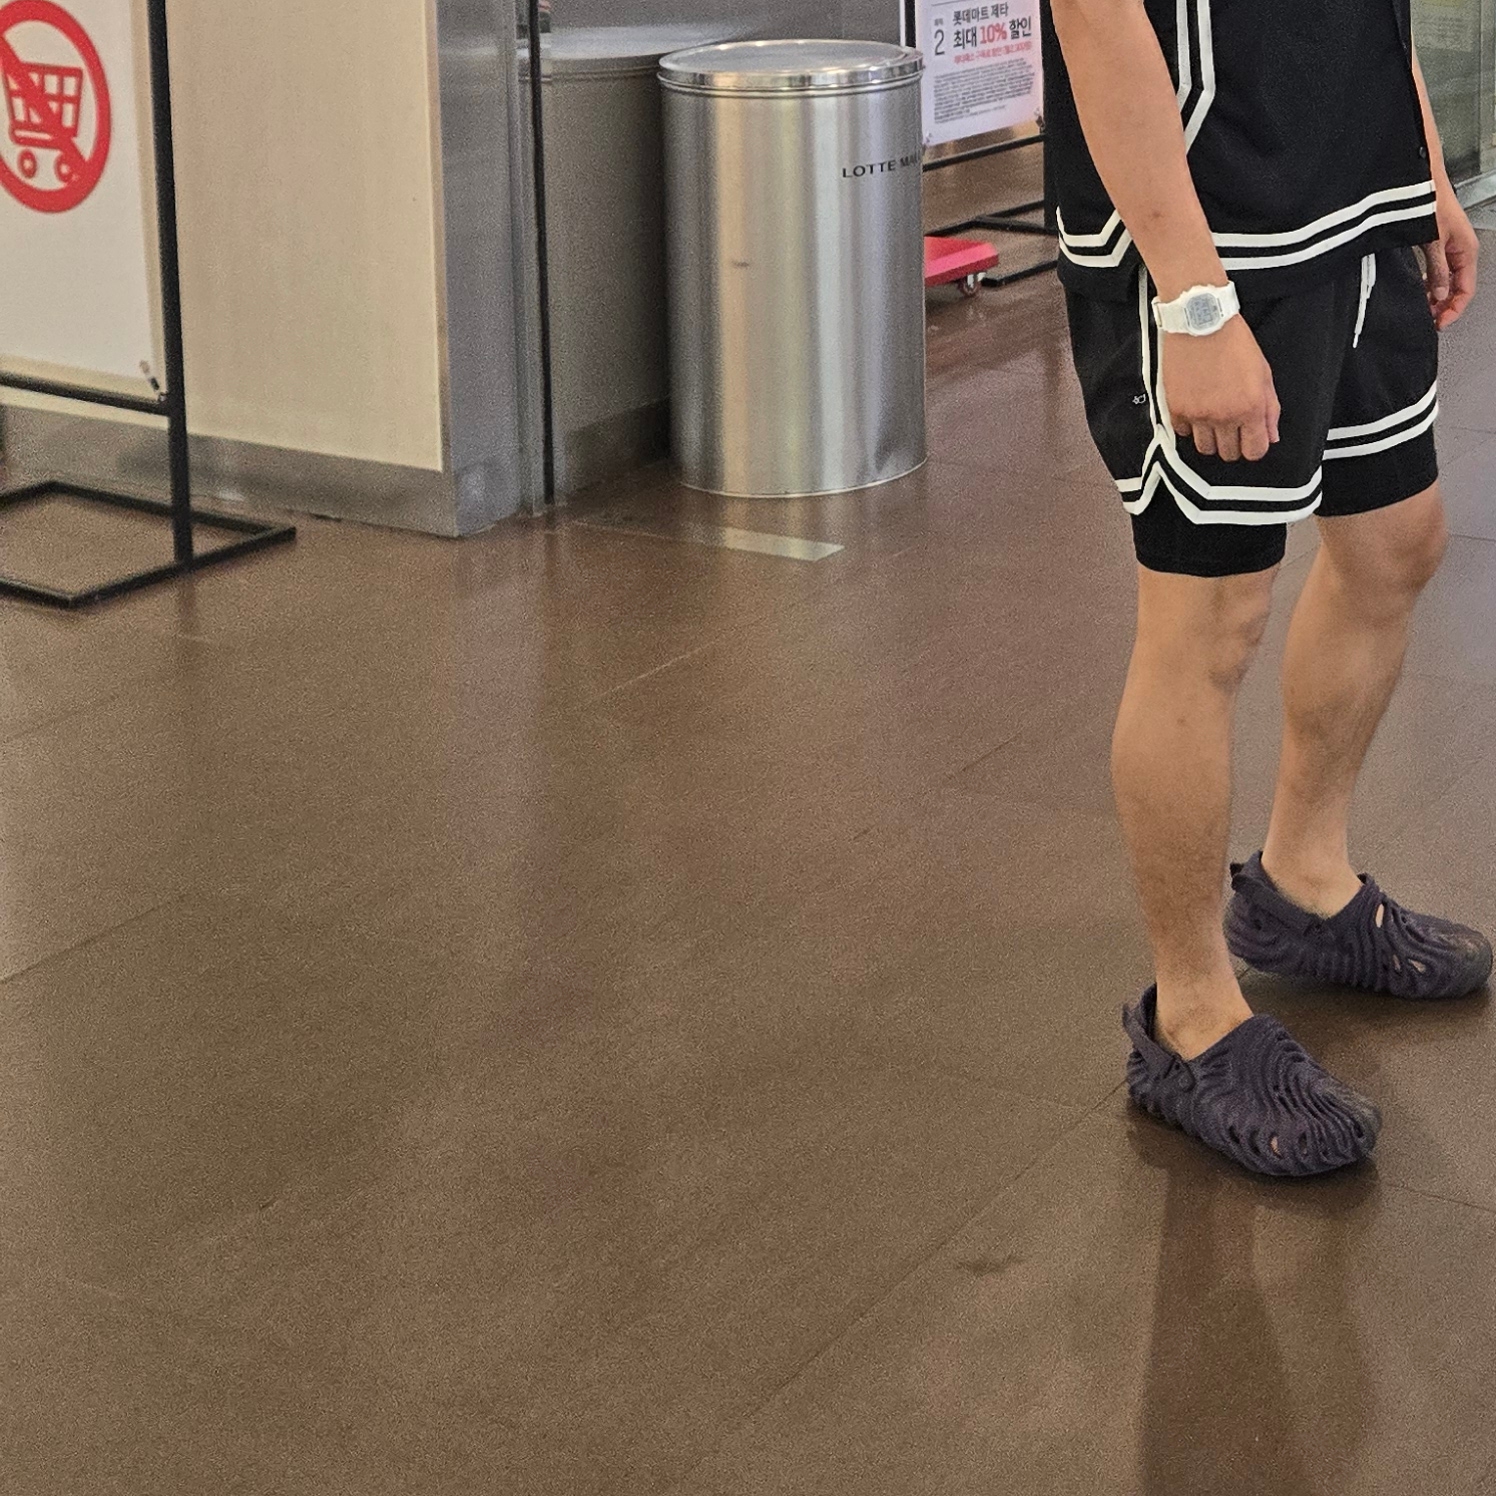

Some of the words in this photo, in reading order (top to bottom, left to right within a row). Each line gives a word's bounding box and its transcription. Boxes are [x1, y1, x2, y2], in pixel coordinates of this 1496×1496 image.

[952, 6, 989, 26] 롯데마트
[934, 29, 945, 56] 2
[953, 26, 977, 50] 최대
[979, 22, 1008, 44] 10%
[1009, 16, 1032, 40] 할인
[842, 160, 897, 178] LOTTE
